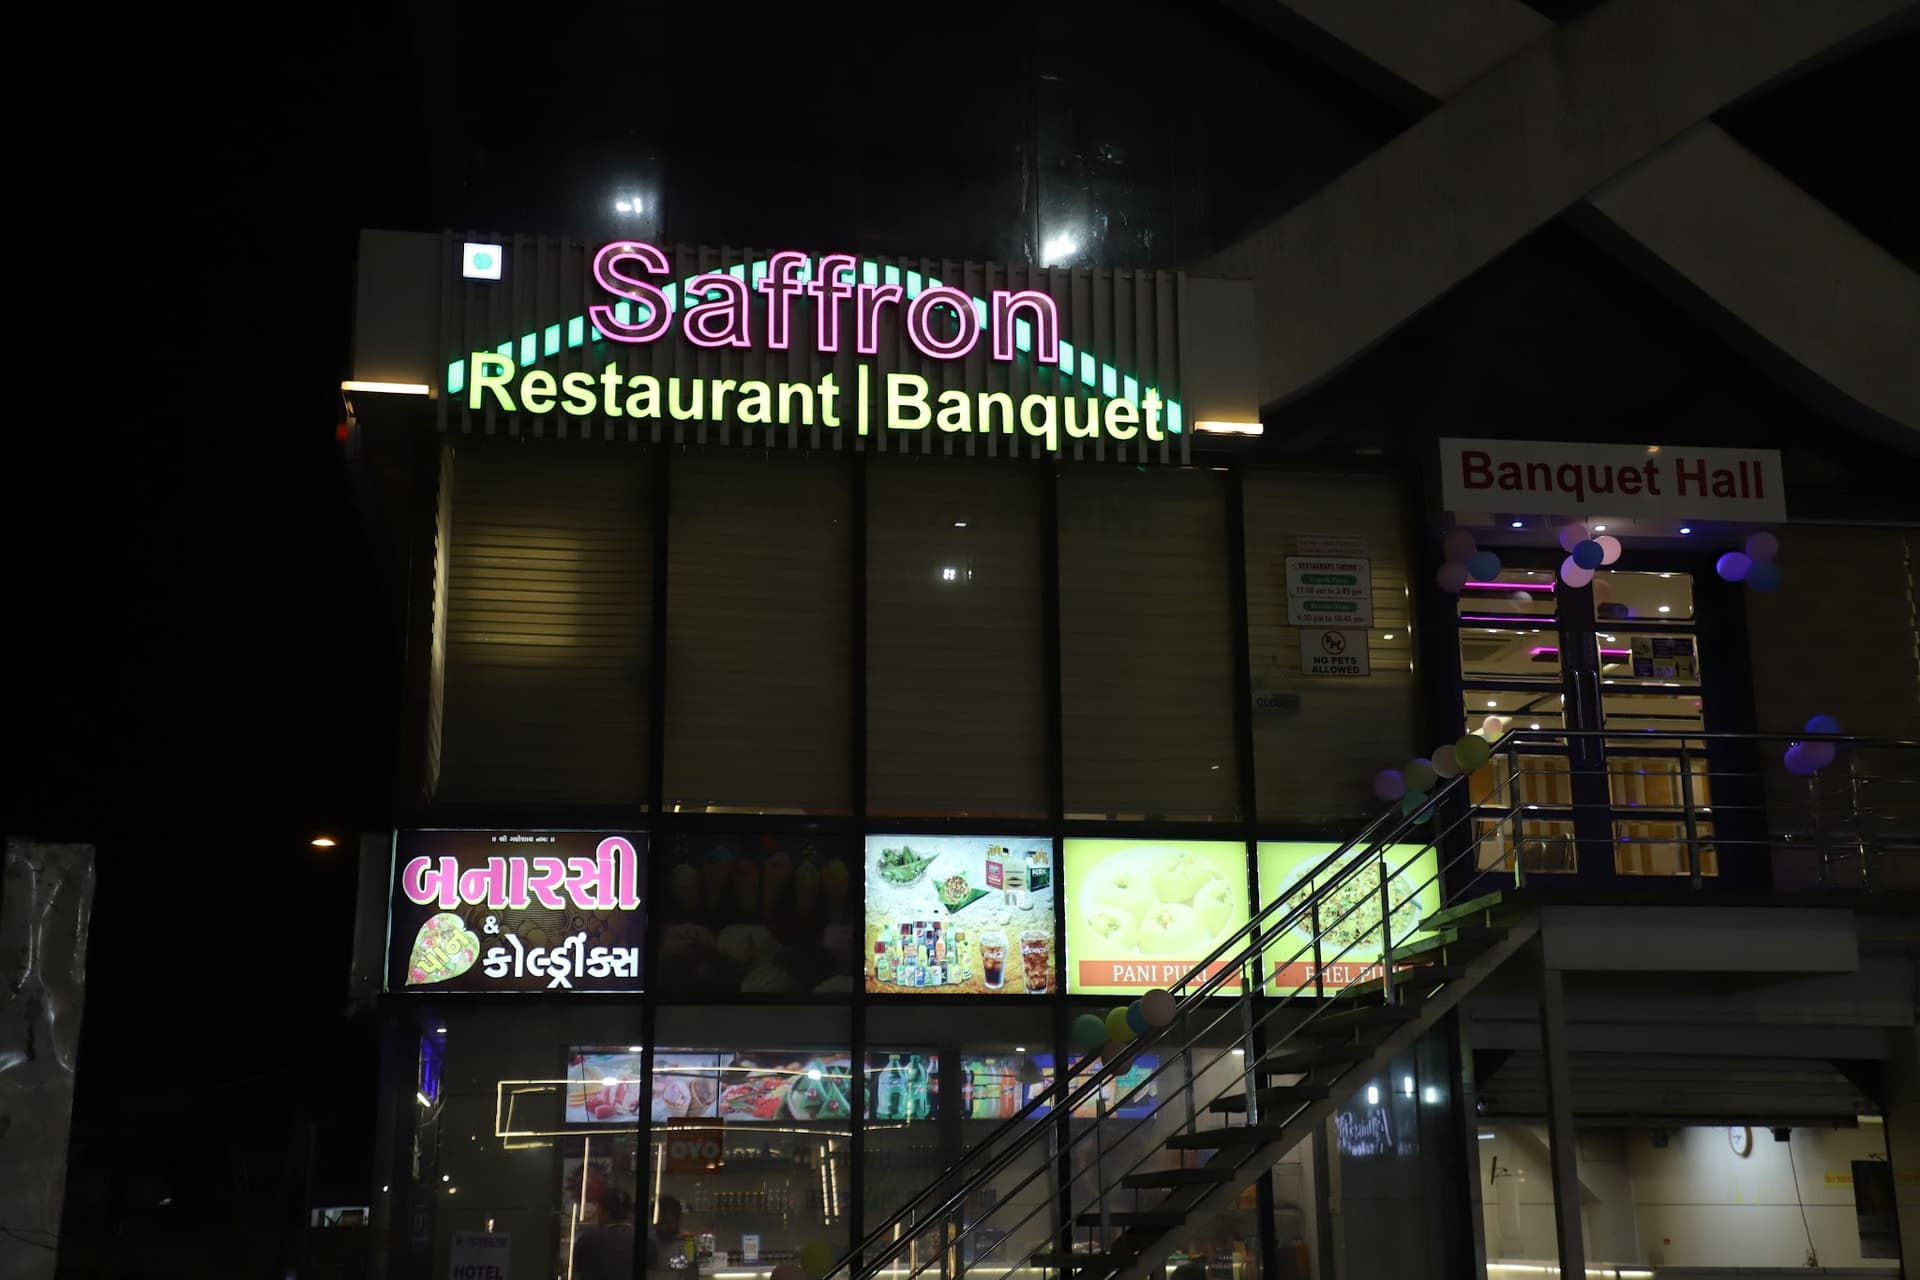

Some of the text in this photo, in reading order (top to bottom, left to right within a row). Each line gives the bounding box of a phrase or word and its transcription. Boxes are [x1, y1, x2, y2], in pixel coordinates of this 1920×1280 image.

[588, 241, 1060, 365] Saffron
[468, 350, 841, 428] Restaurant
[886, 371, 1165, 452] Banquet
[1461, 451, 1764, 503] Banquet Hall
[1313, 656, 1357, 665] NO PETS
[402, 836, 641, 910] બનારસી
[483, 915, 500, 935] &
[416, 929, 469, 975] પાન
[1113, 965, 1157, 982] PANI
[671, 1141, 720, 1160] OYO
[454, 1264, 503, 1280] HOTEL
